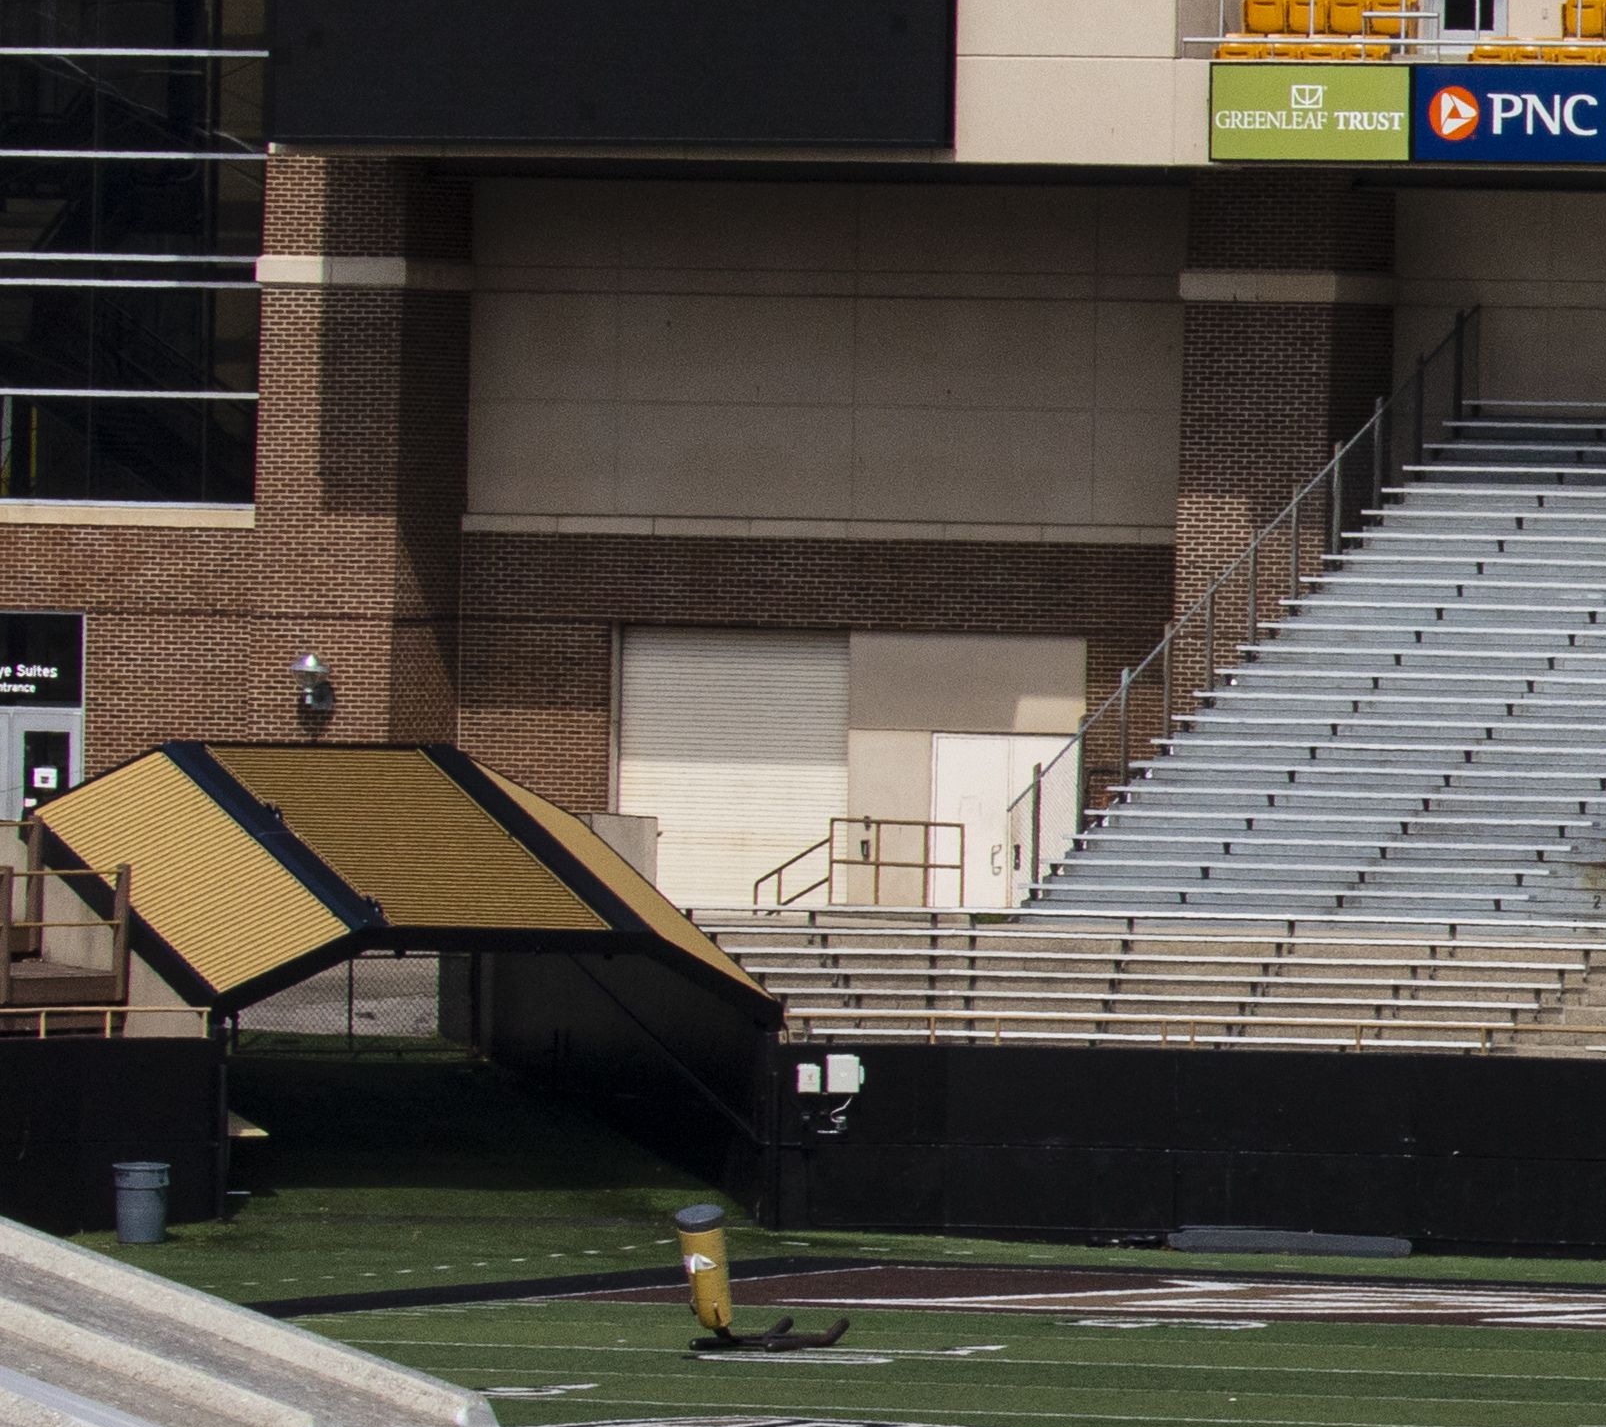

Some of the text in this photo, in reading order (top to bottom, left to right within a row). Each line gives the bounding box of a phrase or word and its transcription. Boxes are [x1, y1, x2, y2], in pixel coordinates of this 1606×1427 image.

[1216, 111, 1404, 129] GREENLEAF TRUST
[1487, 93, 1598, 135] PNC
[16, 664, 58, 678] Suites
